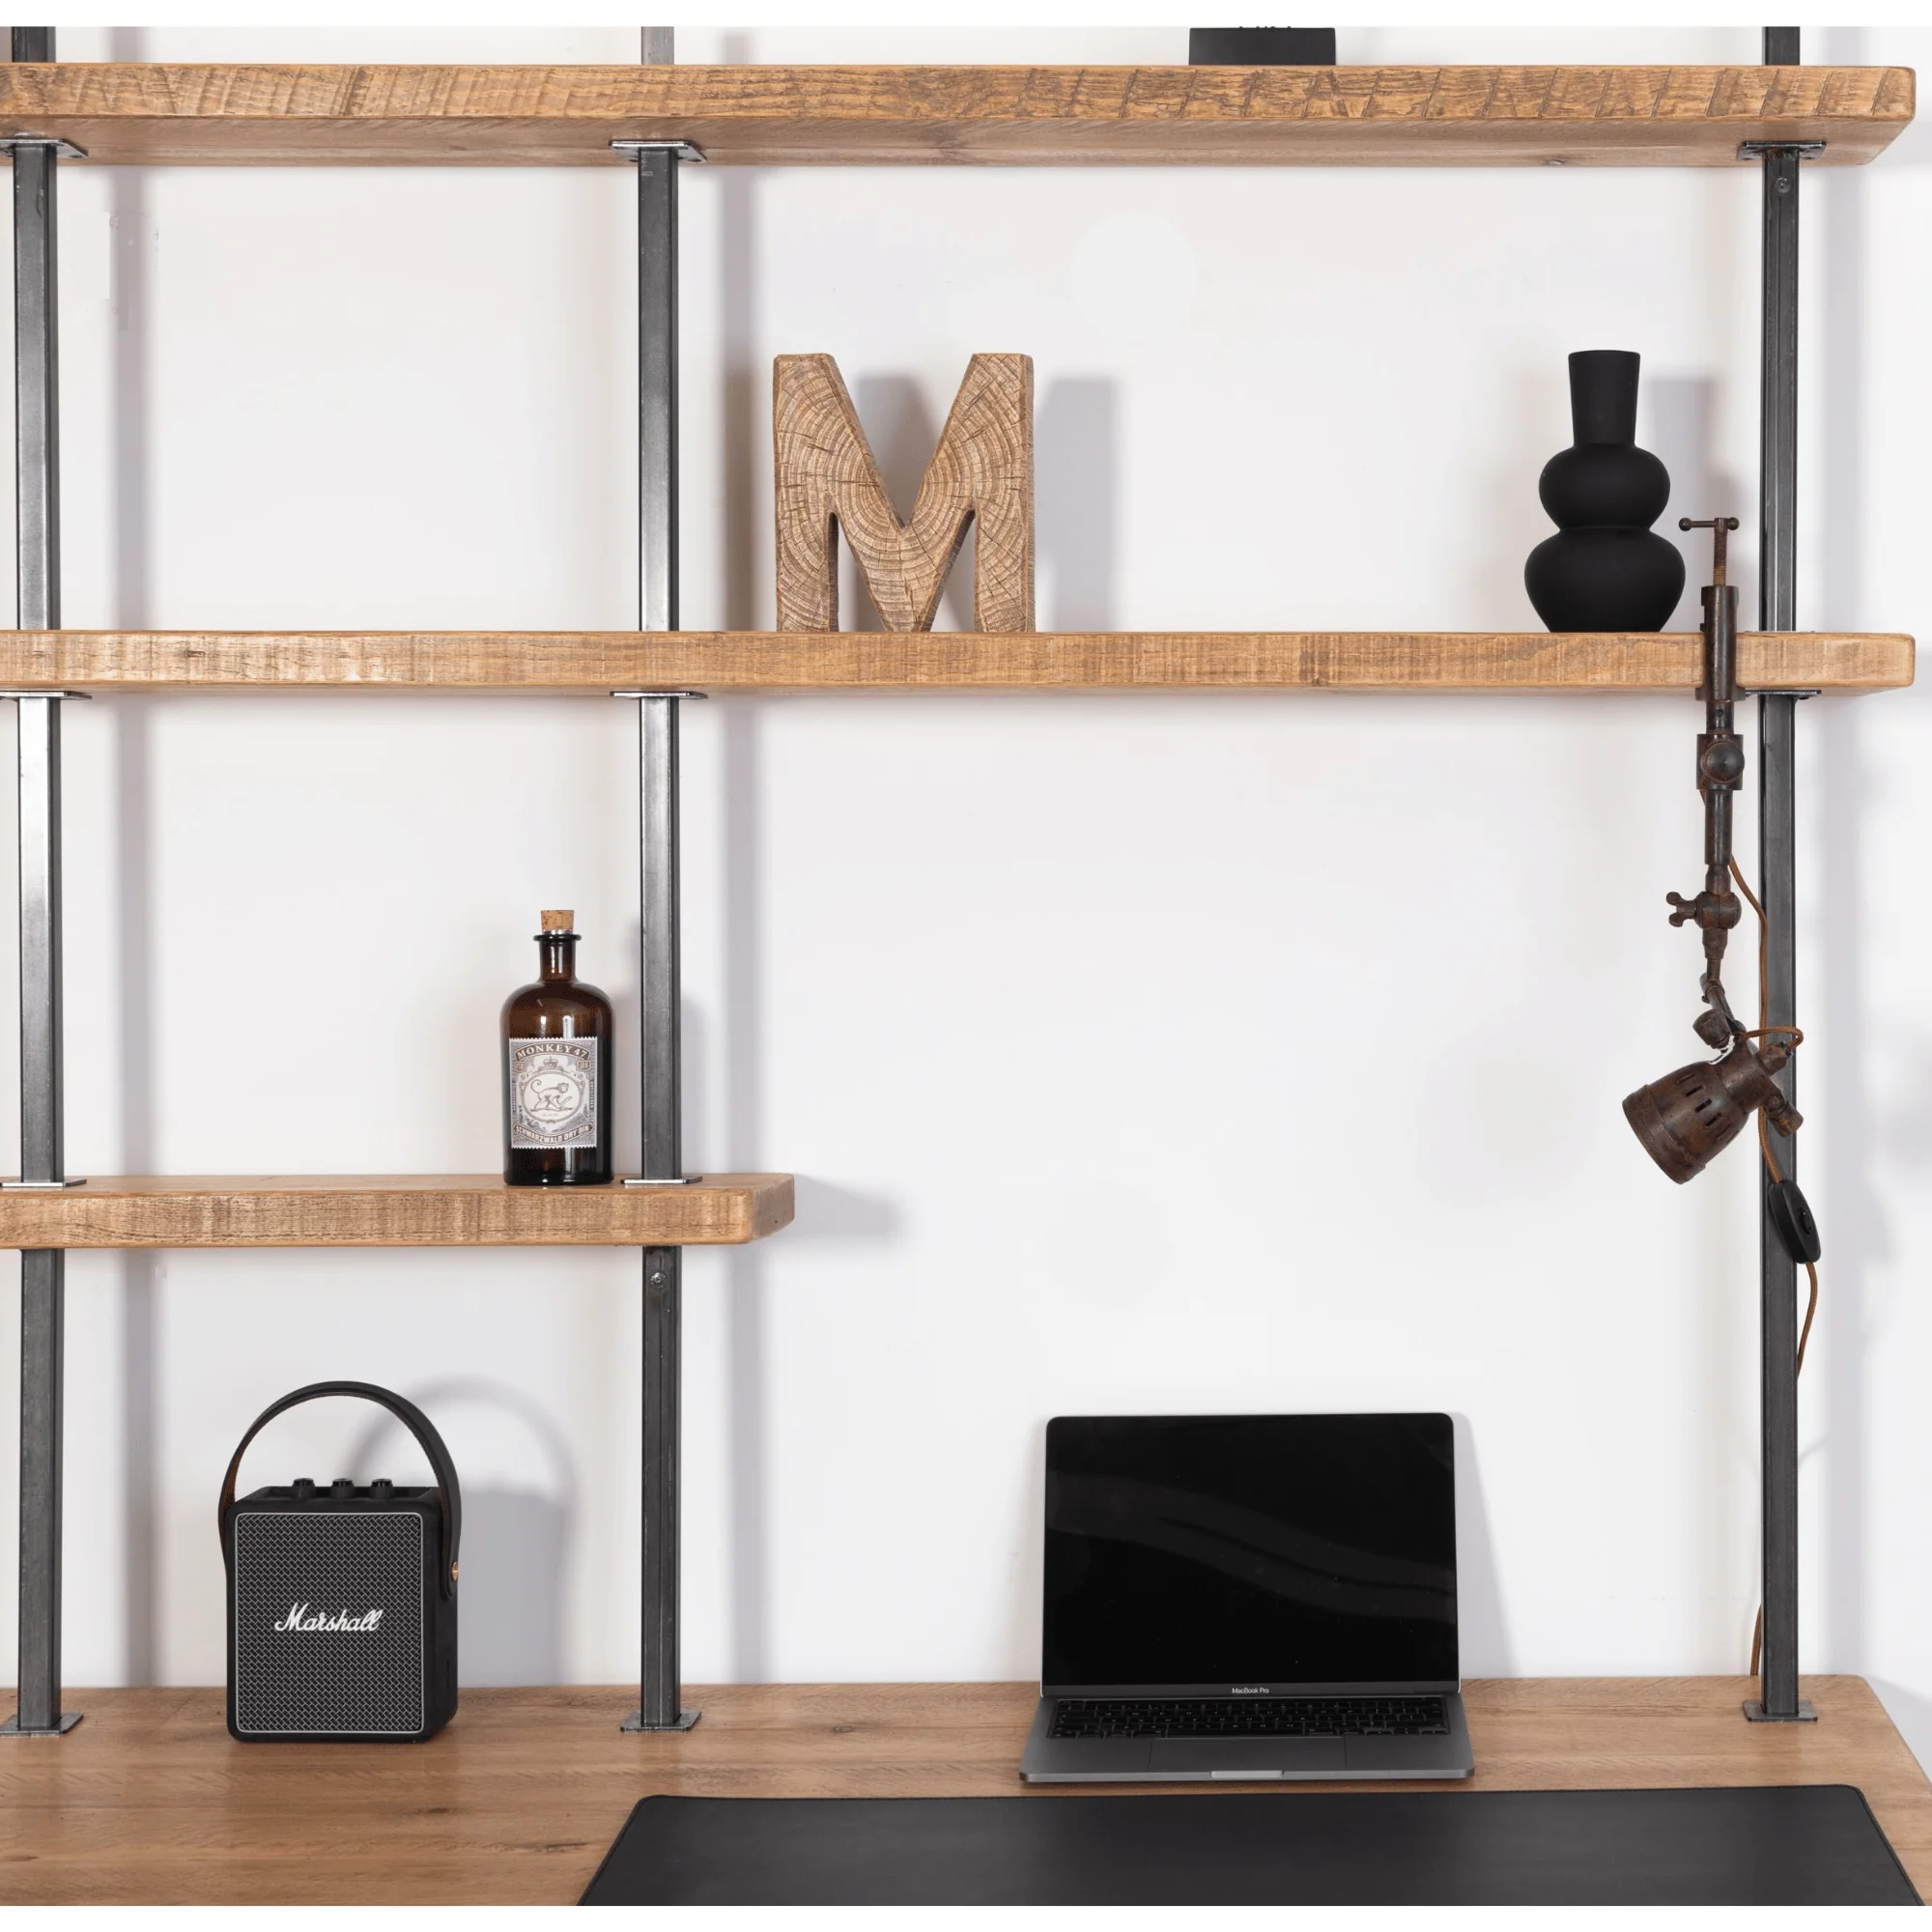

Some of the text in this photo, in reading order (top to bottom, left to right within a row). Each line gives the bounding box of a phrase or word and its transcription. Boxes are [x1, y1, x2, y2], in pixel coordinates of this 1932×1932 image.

[773, 353, 1036, 633] M
[517, 1044, 587, 1059] MONKEY 47
[516, 1125, 563, 1144] SCHWARZWALD
[274, 1602, 384, 1632] Marshall
